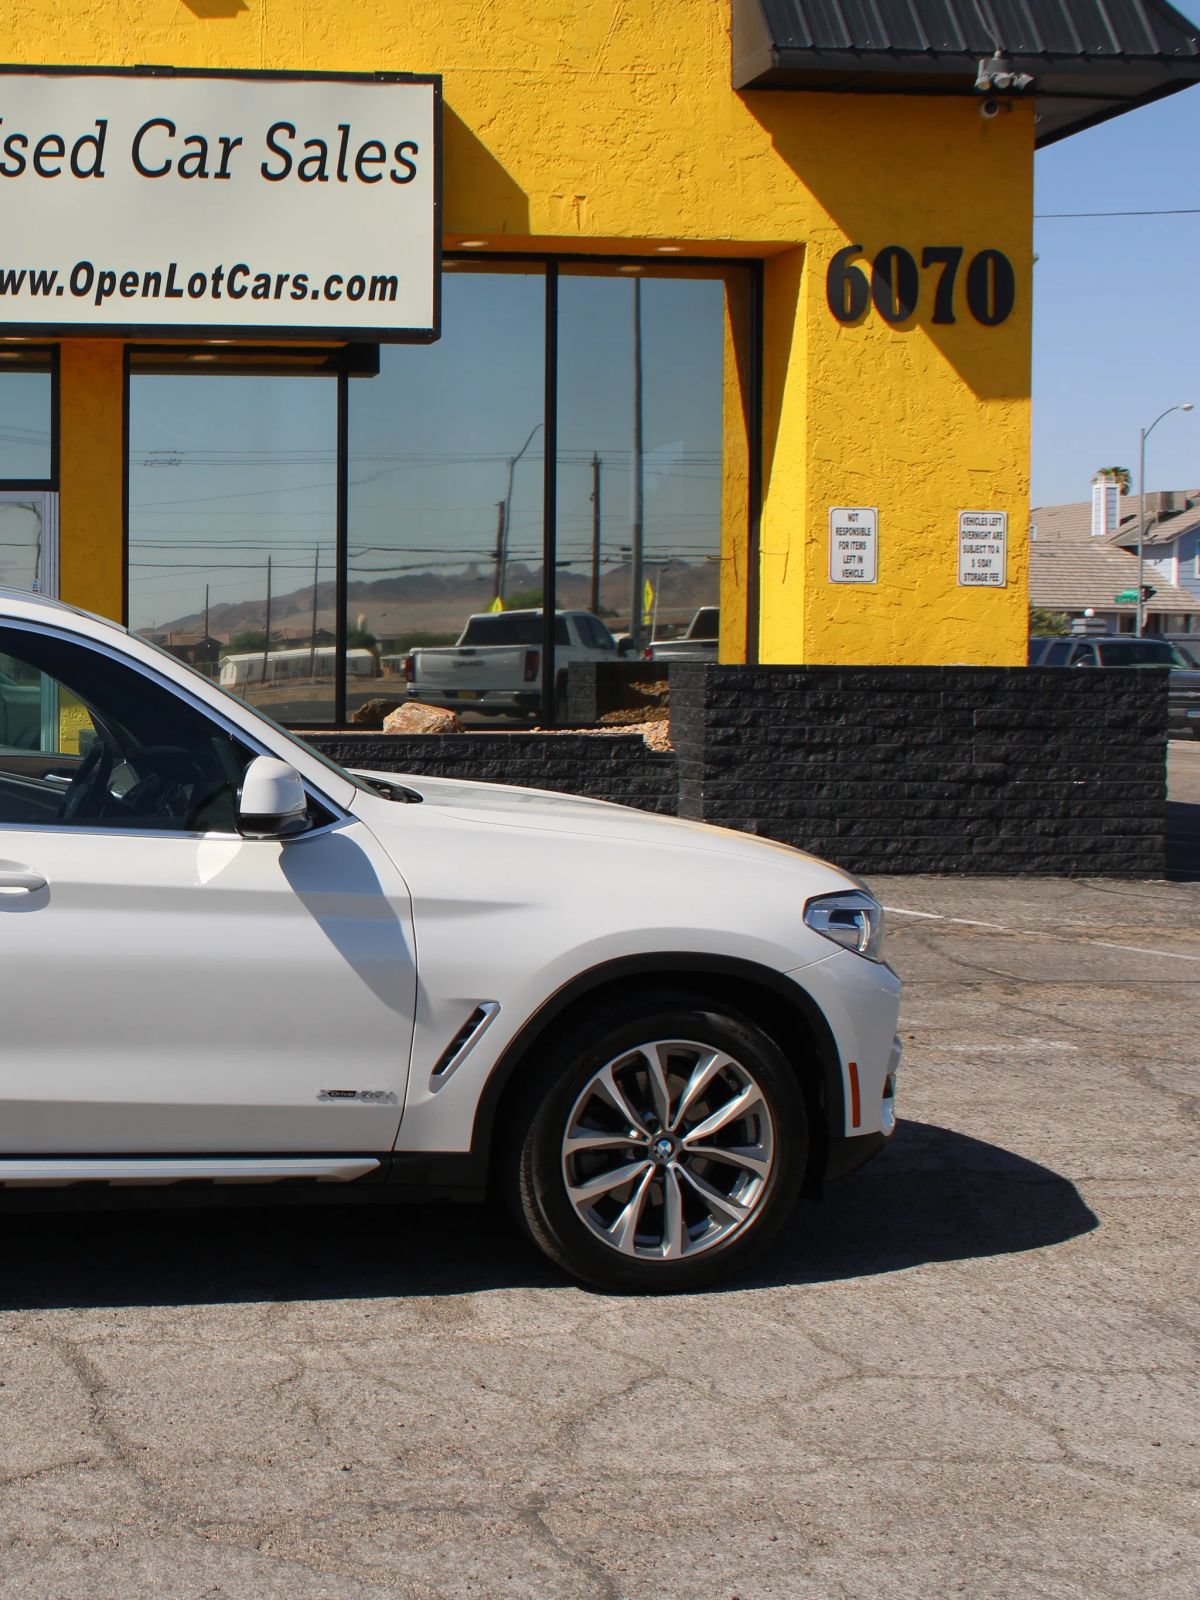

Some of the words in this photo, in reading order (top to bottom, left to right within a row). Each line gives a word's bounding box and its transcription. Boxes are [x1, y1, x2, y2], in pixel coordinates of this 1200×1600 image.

[131, 117, 243, 182] Car
[260, 121, 420, 185] Sales
[826, 244, 1015, 327] 6070
[847, 512, 859, 522] NOT
[962, 516, 988, 526] VEHICLES
[989, 517, 1002, 526] LEFT
[835, 526, 872, 536] RESPONSIBLE
[961, 530, 991, 540] OVERNIGHT
[992, 531, 1004, 540] ARE
[838, 540, 850, 550] FOR
[850, 540, 867, 550] ITEMS
[962, 544, 986, 554] SUBJECT
[987, 544, 995, 554] TO
[843, 554, 856, 564] LEFT
[857, 554, 863, 564] IN
[841, 568, 864, 578] VEHICLE
[963, 572, 989, 582] STORAGE
[989, 572, 1000, 582] FEE
